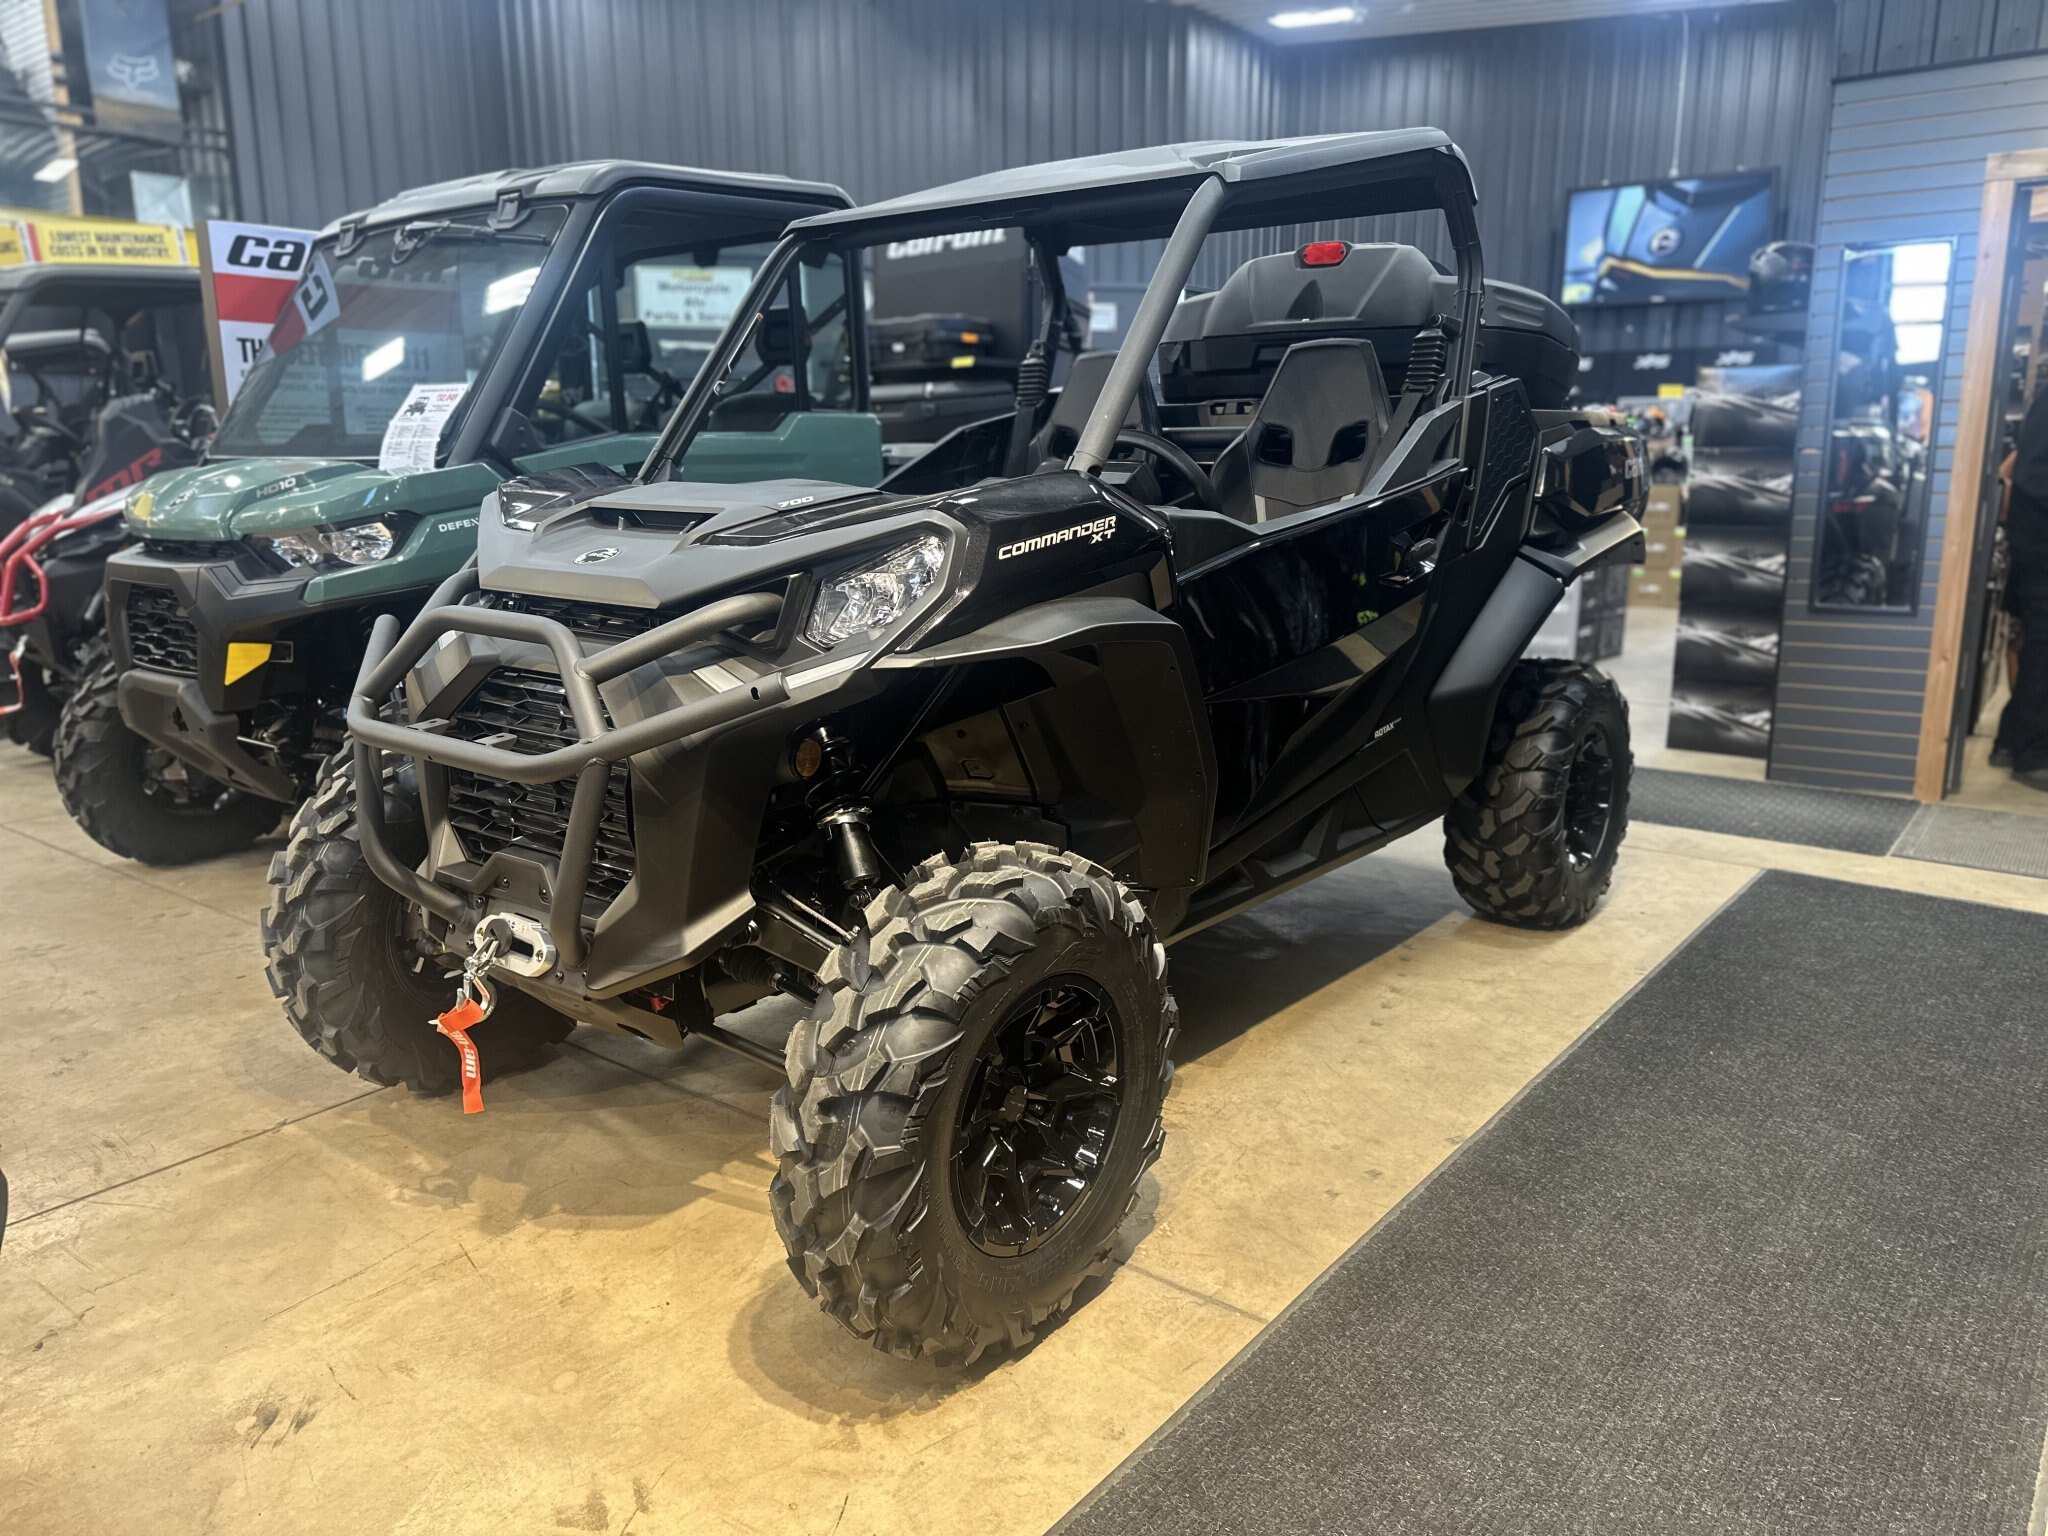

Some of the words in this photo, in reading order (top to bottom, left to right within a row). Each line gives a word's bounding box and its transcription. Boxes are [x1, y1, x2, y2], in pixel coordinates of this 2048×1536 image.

[94, 232, 165, 244] MAINTENANCE
[50, 245, 84, 258] COSTS
[87, 246, 98, 258] IN
[101, 246, 120, 258] THE
[236, 337, 266, 364] TH
[256, 477, 297, 499] HD10
[777, 495, 814, 509] 700
[438, 517, 480, 533] DEFEN
[998, 515, 1117, 560] COMMANDER
[1090, 528, 1116, 545] XT
[1374, 722, 1395, 739] ROTAX
